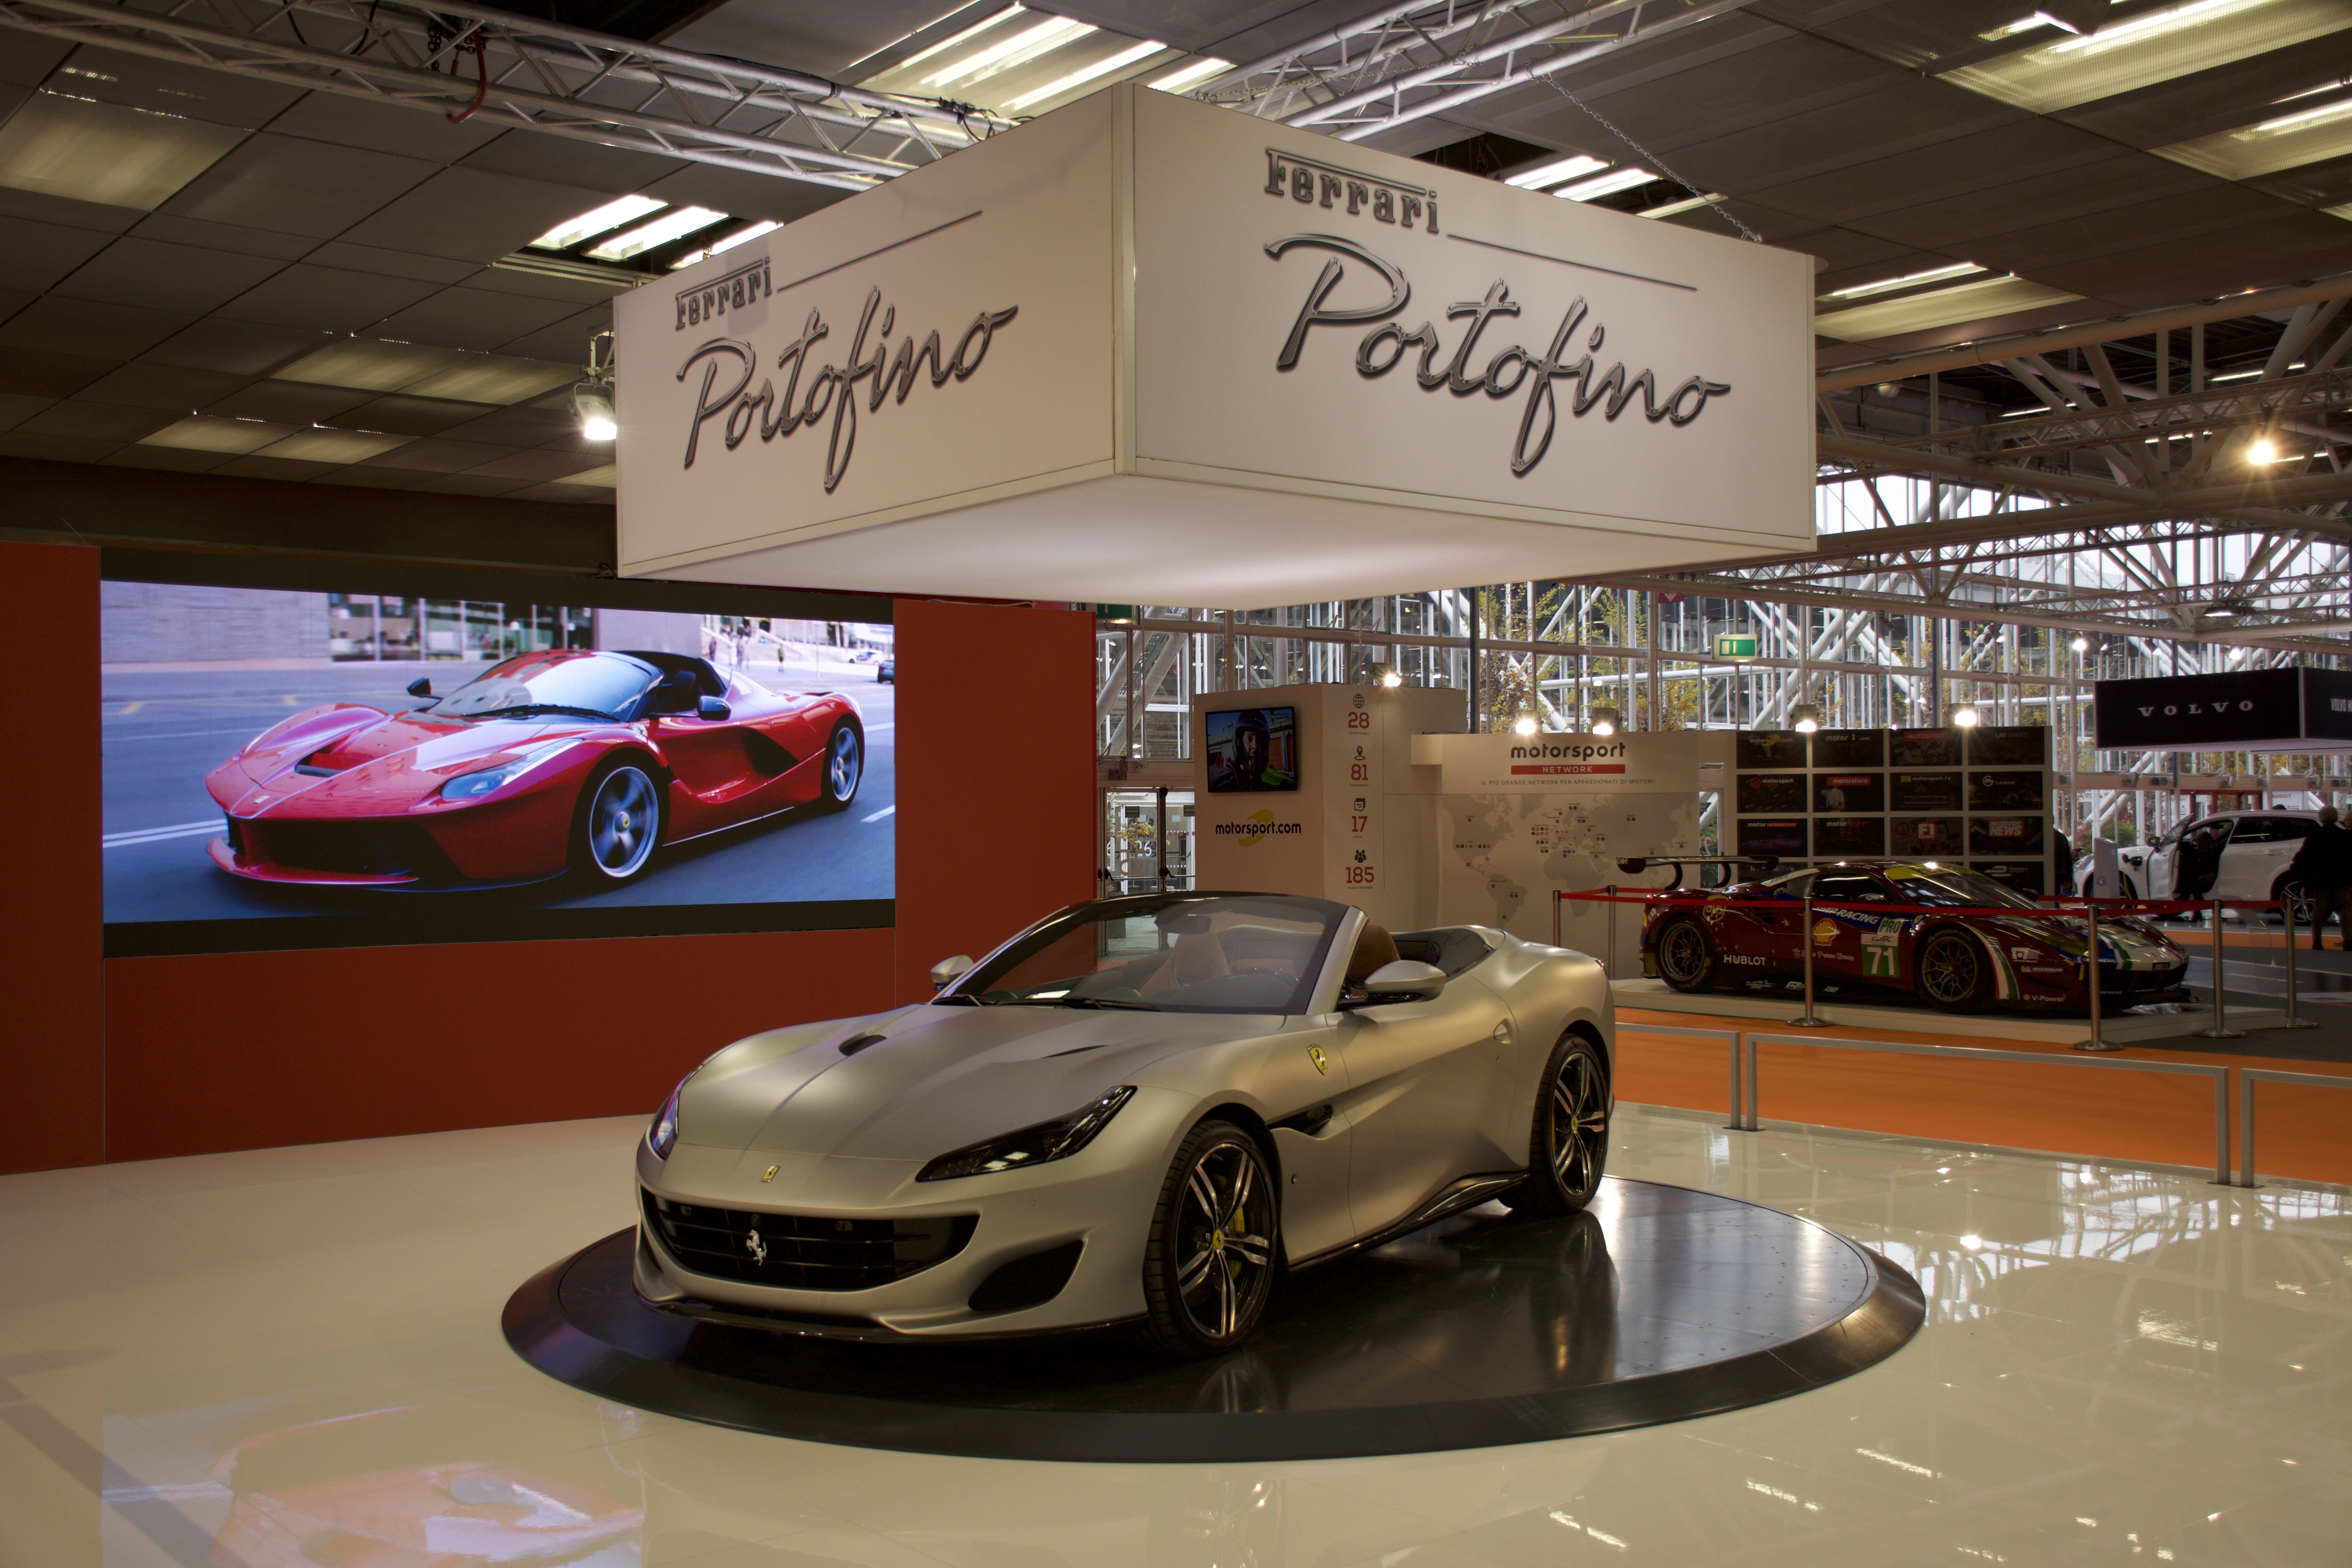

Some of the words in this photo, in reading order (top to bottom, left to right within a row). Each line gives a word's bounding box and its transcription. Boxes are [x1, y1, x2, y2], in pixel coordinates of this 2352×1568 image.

[1265, 147, 1439, 234] Ferrari
[675, 257, 773, 329] Ferrari
[1264, 234, 1731, 478] Portofino
[677, 284, 1018, 495] Portofino
[2138, 701, 2253, 717] VOLVO
[2330, 698, 2346, 711] VOLVO
[1348, 711, 1370, 729] 28
[1511, 742, 1626, 761] motorsport
[1351, 764, 1368, 781] 81
[1215, 821, 1301, 837] motorsport.com
[1352, 816, 1367, 832] 17
[1918, 824, 1934, 835] F1
[1989, 826, 2022, 836] NEWS
[1346, 866, 1374, 884] 185
[1836, 909, 1880, 924] RACING
[1879, 920, 1900, 933] PRO
[1723, 954, 1767, 966] HUBLOT
[1836, 952, 1854, 962] Group
[1866, 947, 1894, 975] 71
